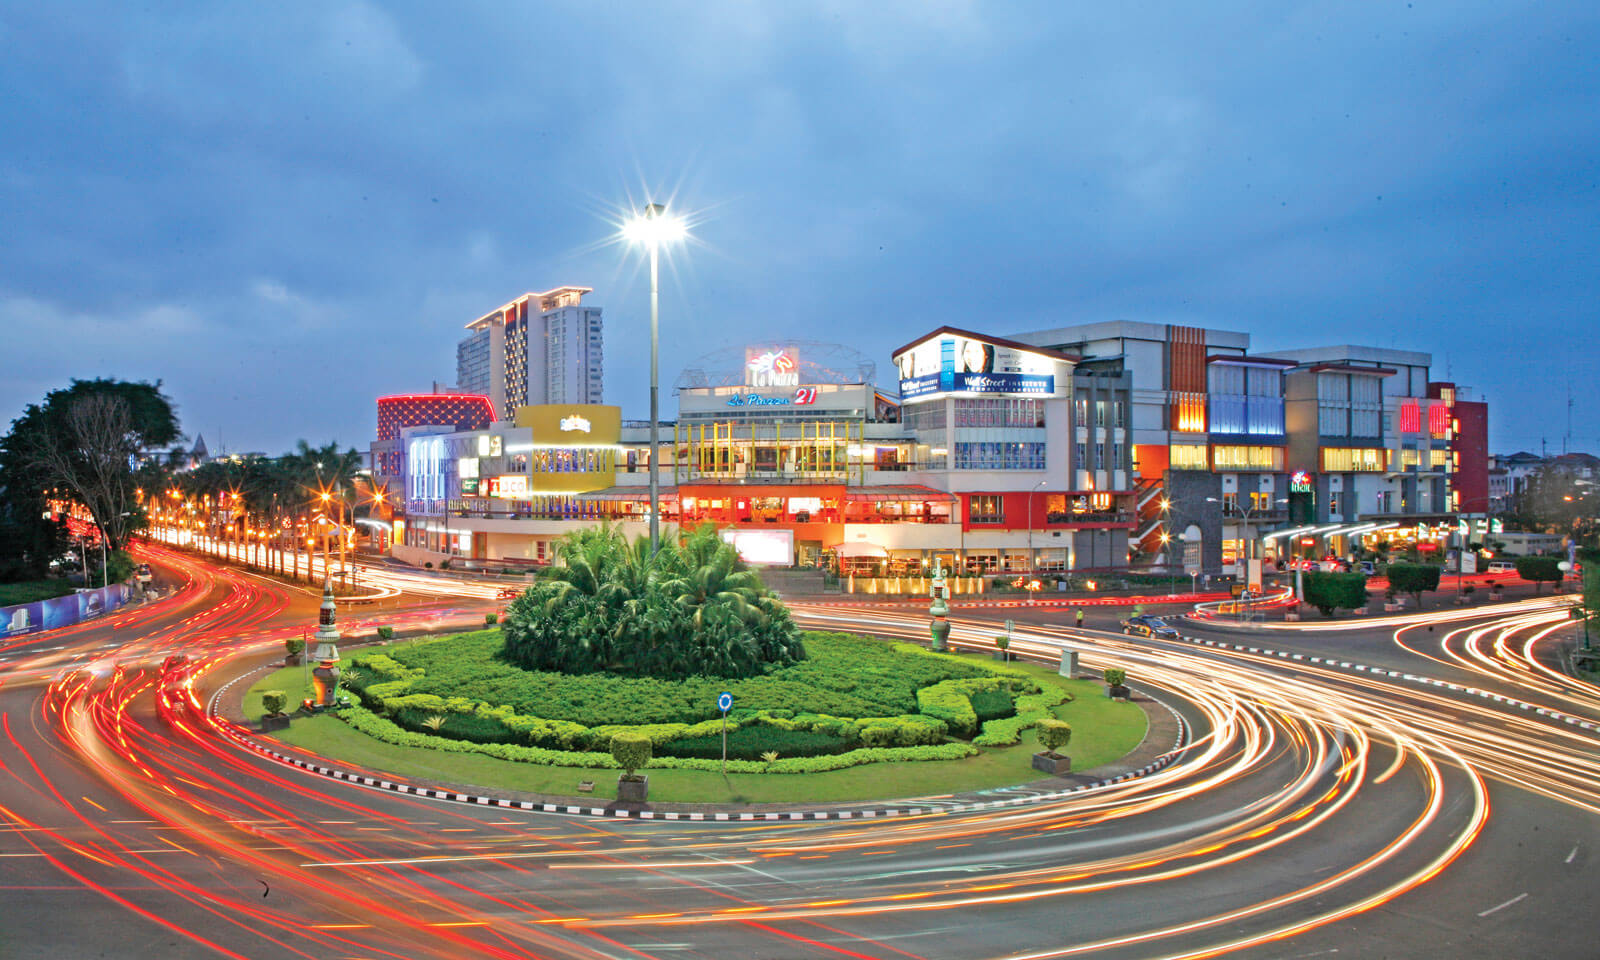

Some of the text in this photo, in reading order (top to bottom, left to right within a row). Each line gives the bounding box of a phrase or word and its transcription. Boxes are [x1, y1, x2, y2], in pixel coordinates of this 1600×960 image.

[982, 376, 1006, 387] Street
[747, 393, 789, 406] Piazza
[794, 388, 816, 405] 21
